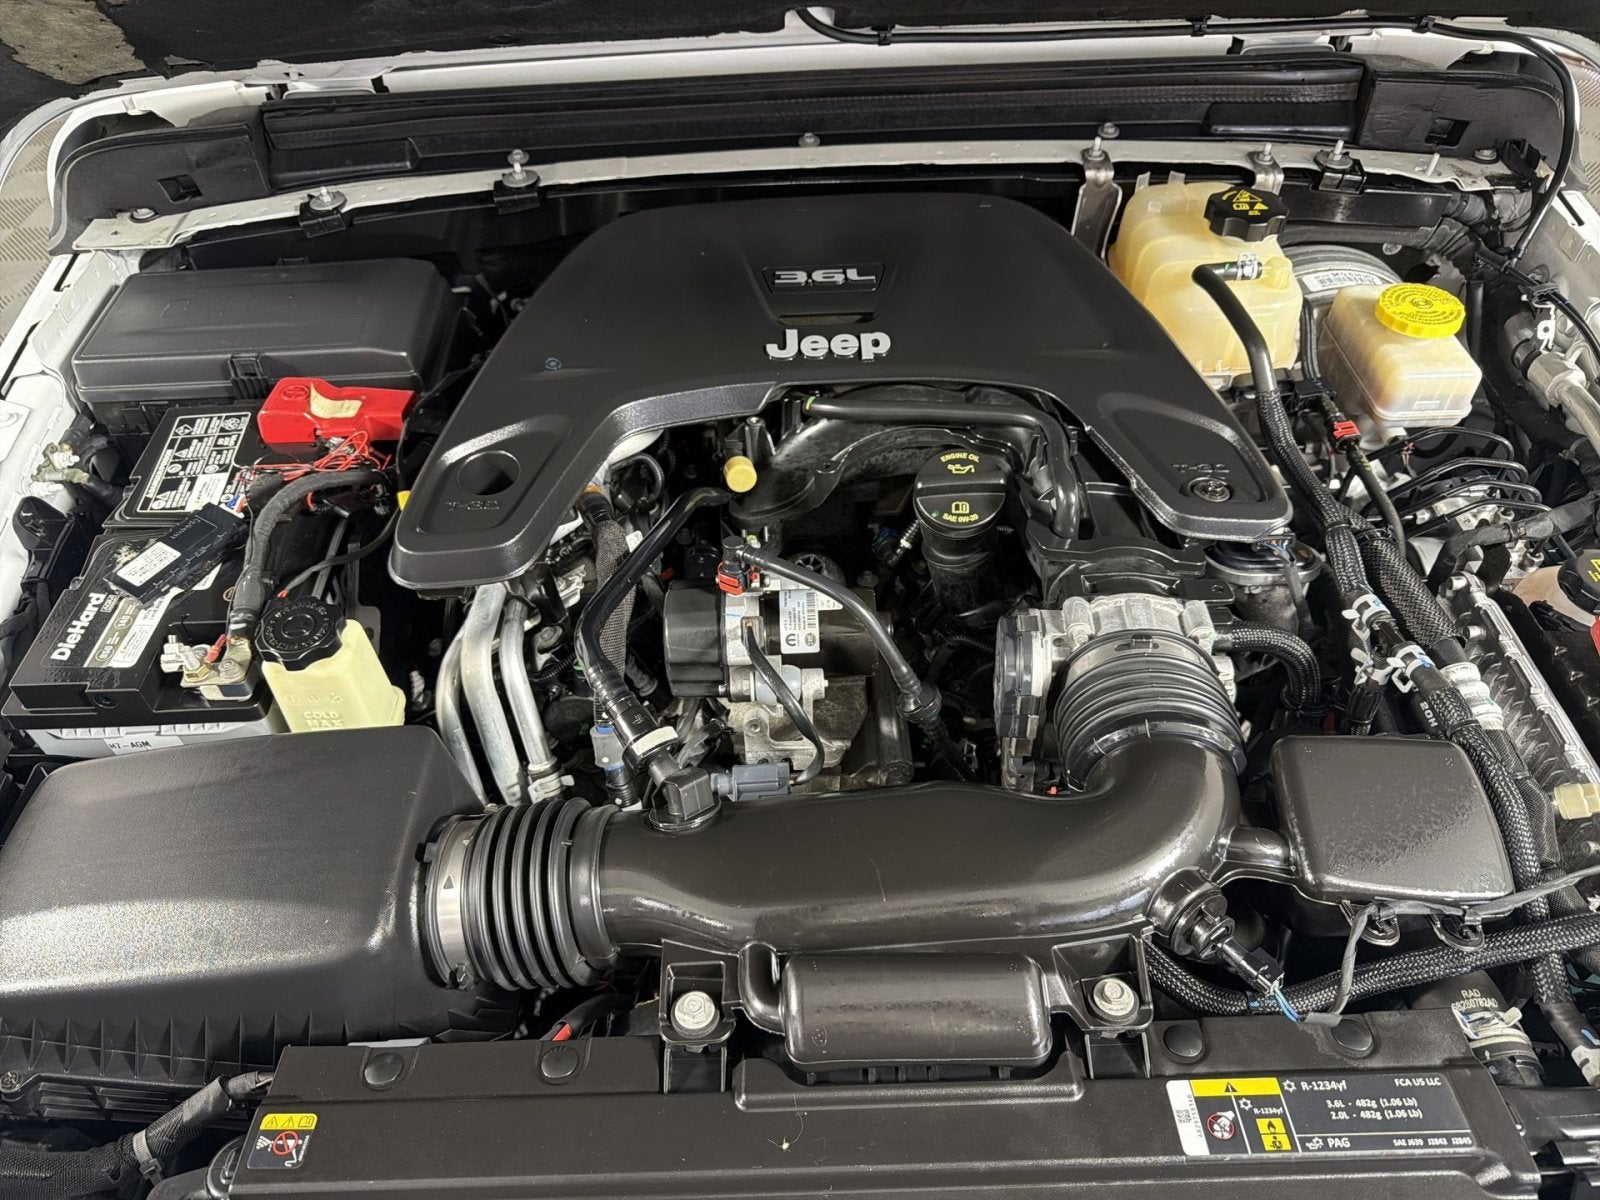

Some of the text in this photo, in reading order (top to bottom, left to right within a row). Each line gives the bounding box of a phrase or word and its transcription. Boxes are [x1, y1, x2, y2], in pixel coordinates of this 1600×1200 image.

[775, 268, 876, 285] 3.6L
[765, 328, 891, 361] Jeep
[940, 452, 980, 463] ENGINE OIL
[942, 512, 957, 522] SAE
[50, 592, 108, 661] DieHard
[303, 711, 339, 720] COLD
[306, 719, 344, 728] MAX
[1460, 988, 1481, 999] RAD
[1300, 1080, 1347, 1092] R-1234yf
[1394, 1077, 1442, 1087] FCA US LLC
[1325, 1099, 1345, 1108] 3.6L
[1355, 1099, 1378, 1108] 482g
[1253, 1107, 1284, 1116] R-1234yf
[1330, 1111, 1350, 1120] 2.0L
[1360, 1110, 1383, 1120] 482g
[1327, 1137, 1351, 1148] PAG
[1393, 1138, 1407, 1147] SAE
